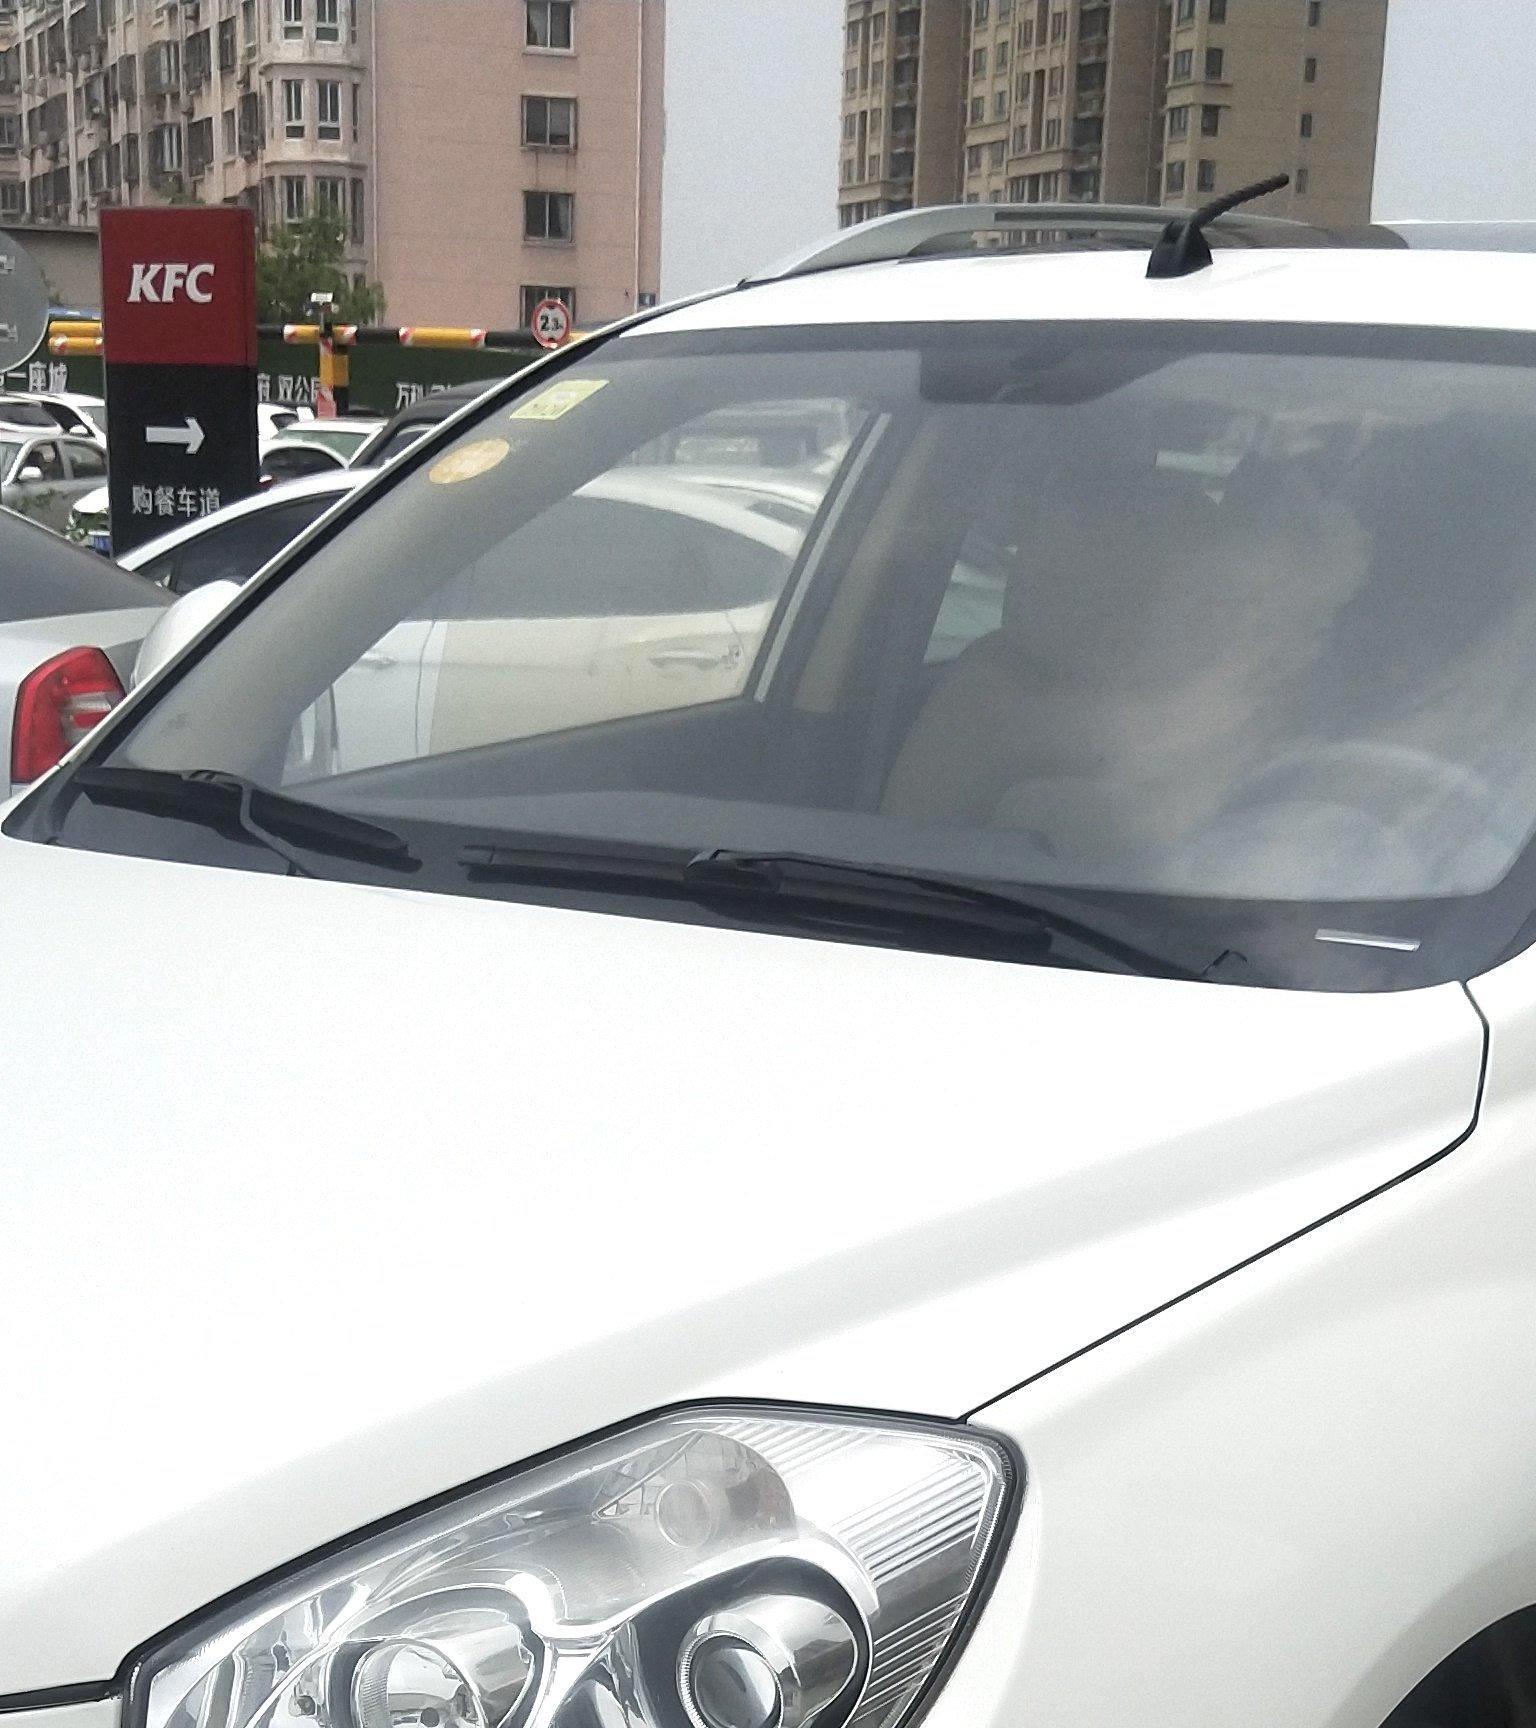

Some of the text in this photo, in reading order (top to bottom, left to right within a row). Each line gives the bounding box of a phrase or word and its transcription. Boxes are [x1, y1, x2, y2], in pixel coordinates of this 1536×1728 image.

[127, 263, 215, 303] KFC
[132, 484, 221, 517] 购餐车道
